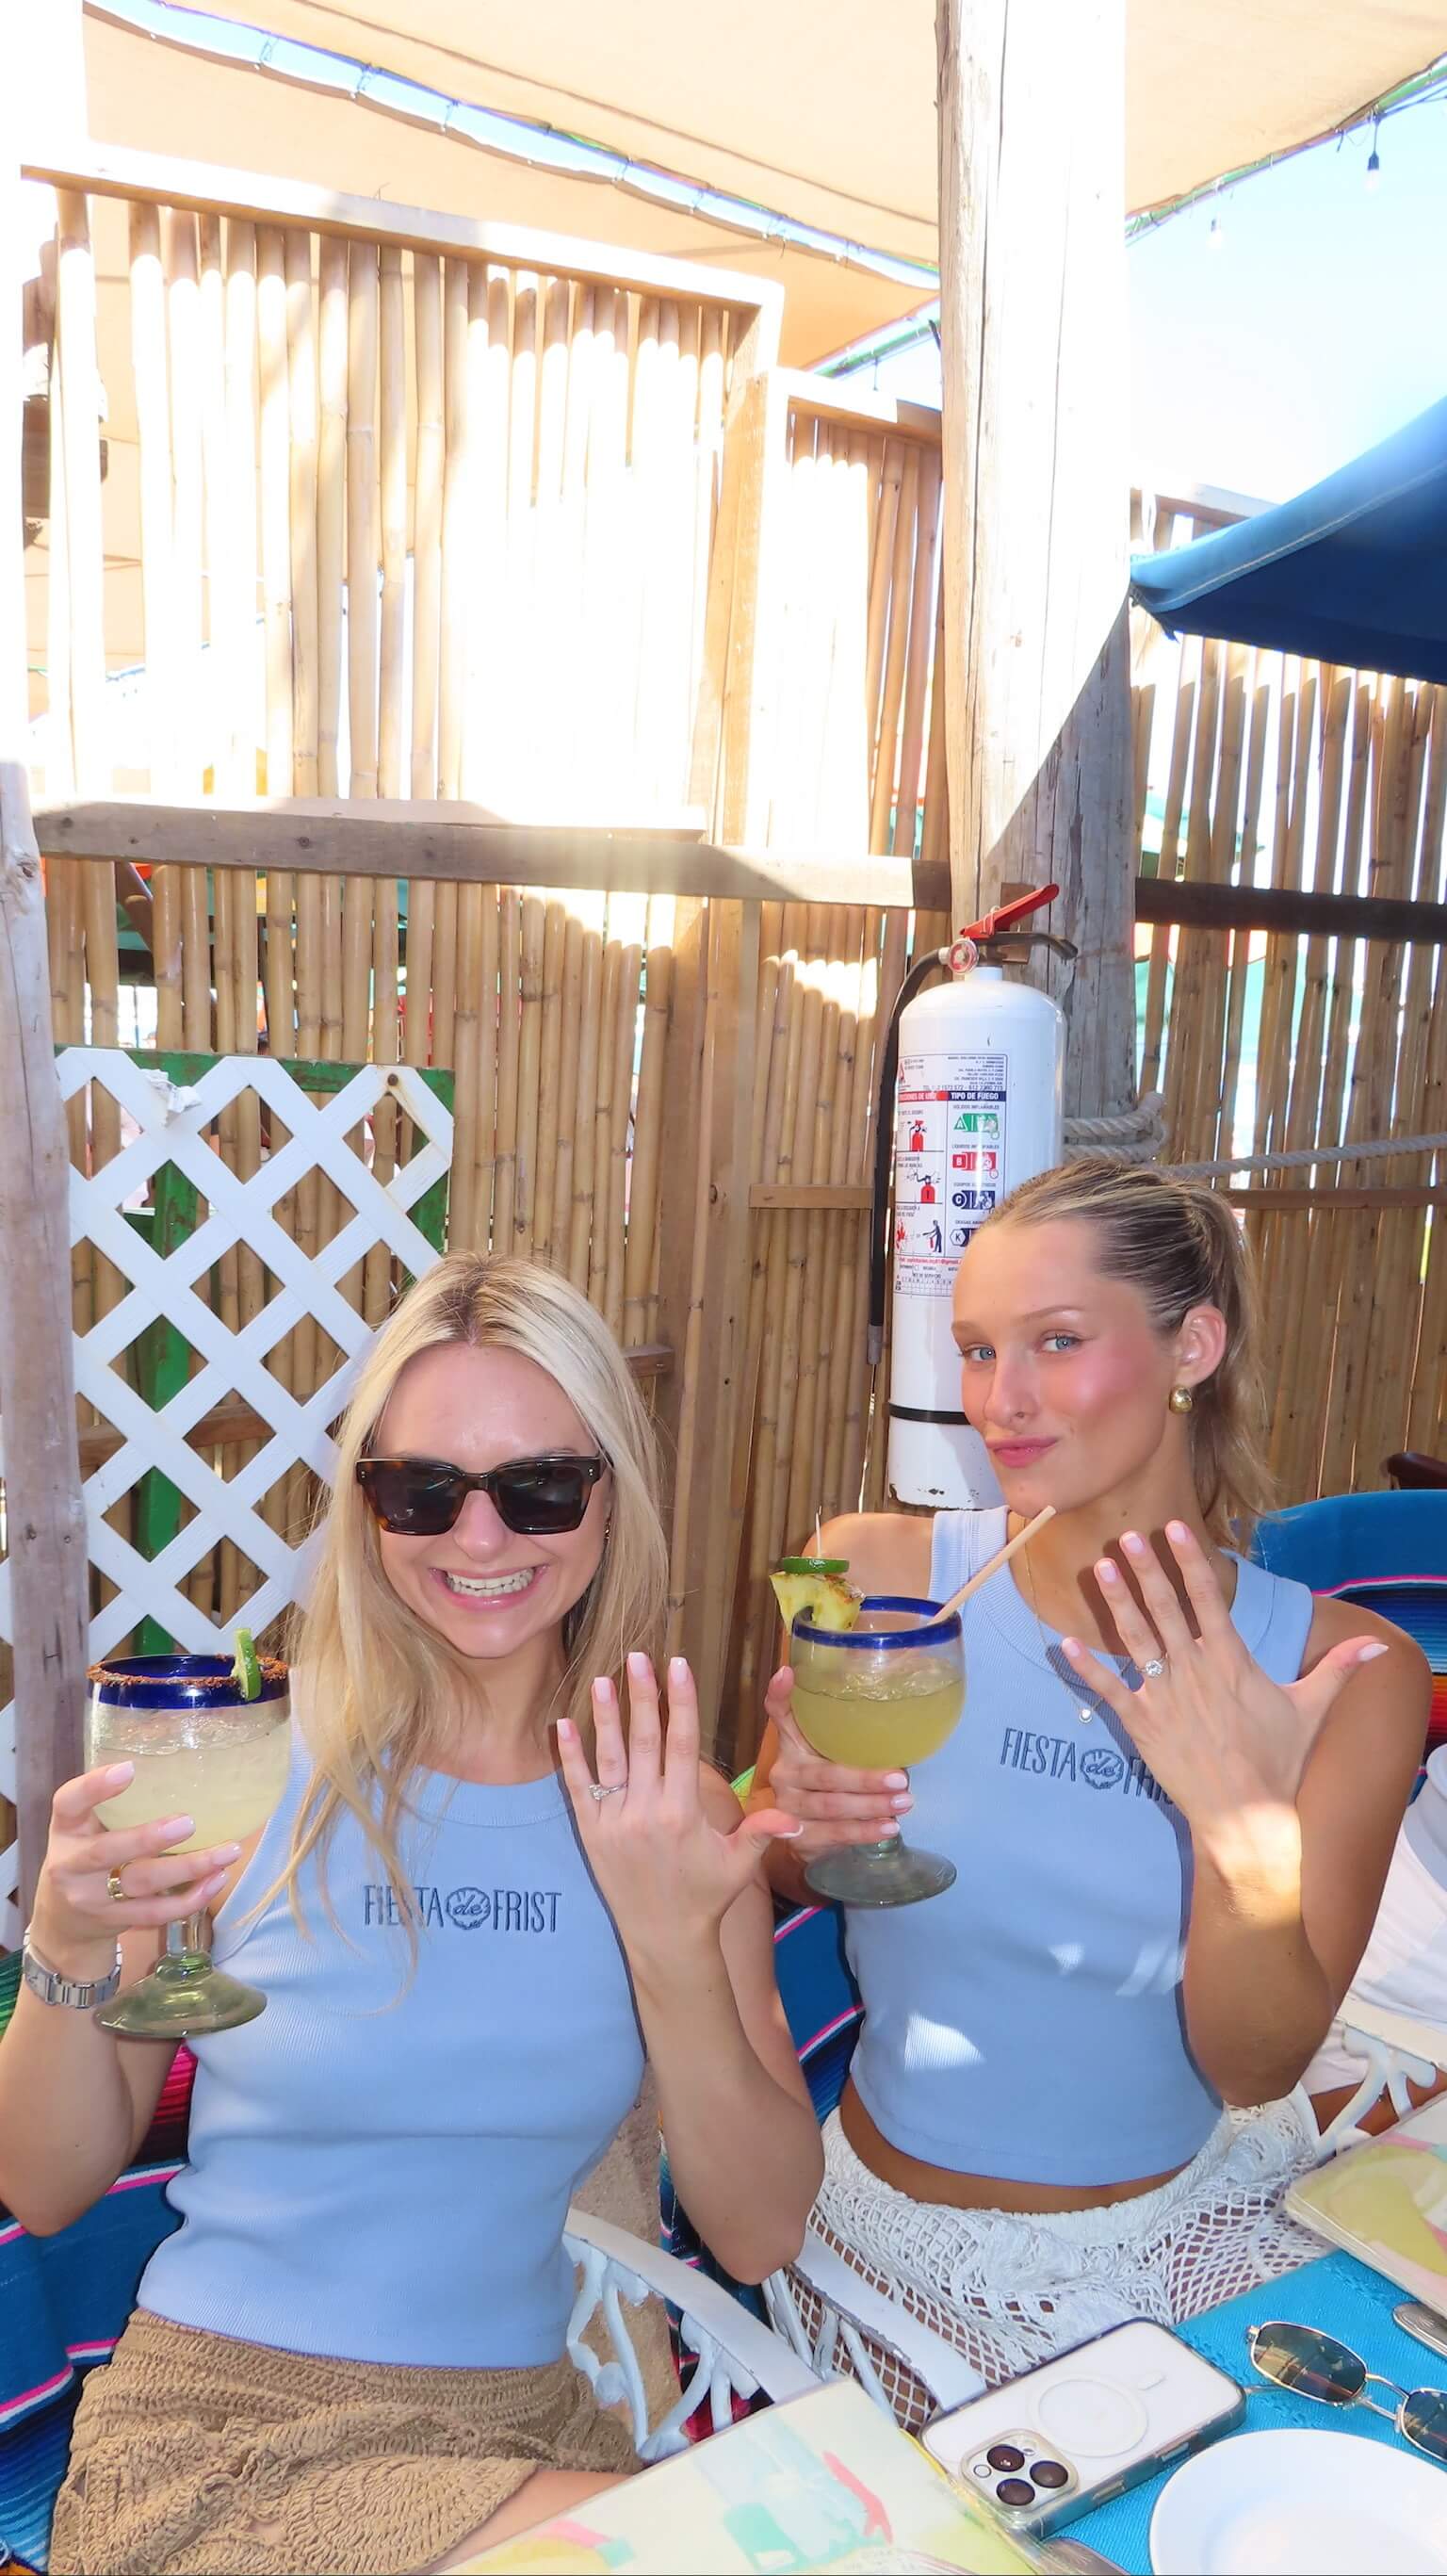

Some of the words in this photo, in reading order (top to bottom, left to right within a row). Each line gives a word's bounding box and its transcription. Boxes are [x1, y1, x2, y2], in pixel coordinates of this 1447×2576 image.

[1000, 1728, 1076, 1782] FIESTA
[1085, 1755, 1115, 1778] de
[364, 1884, 444, 1928] FIETA
[453, 1894, 482, 1916] de
[493, 1889, 562, 1932] FRIST
